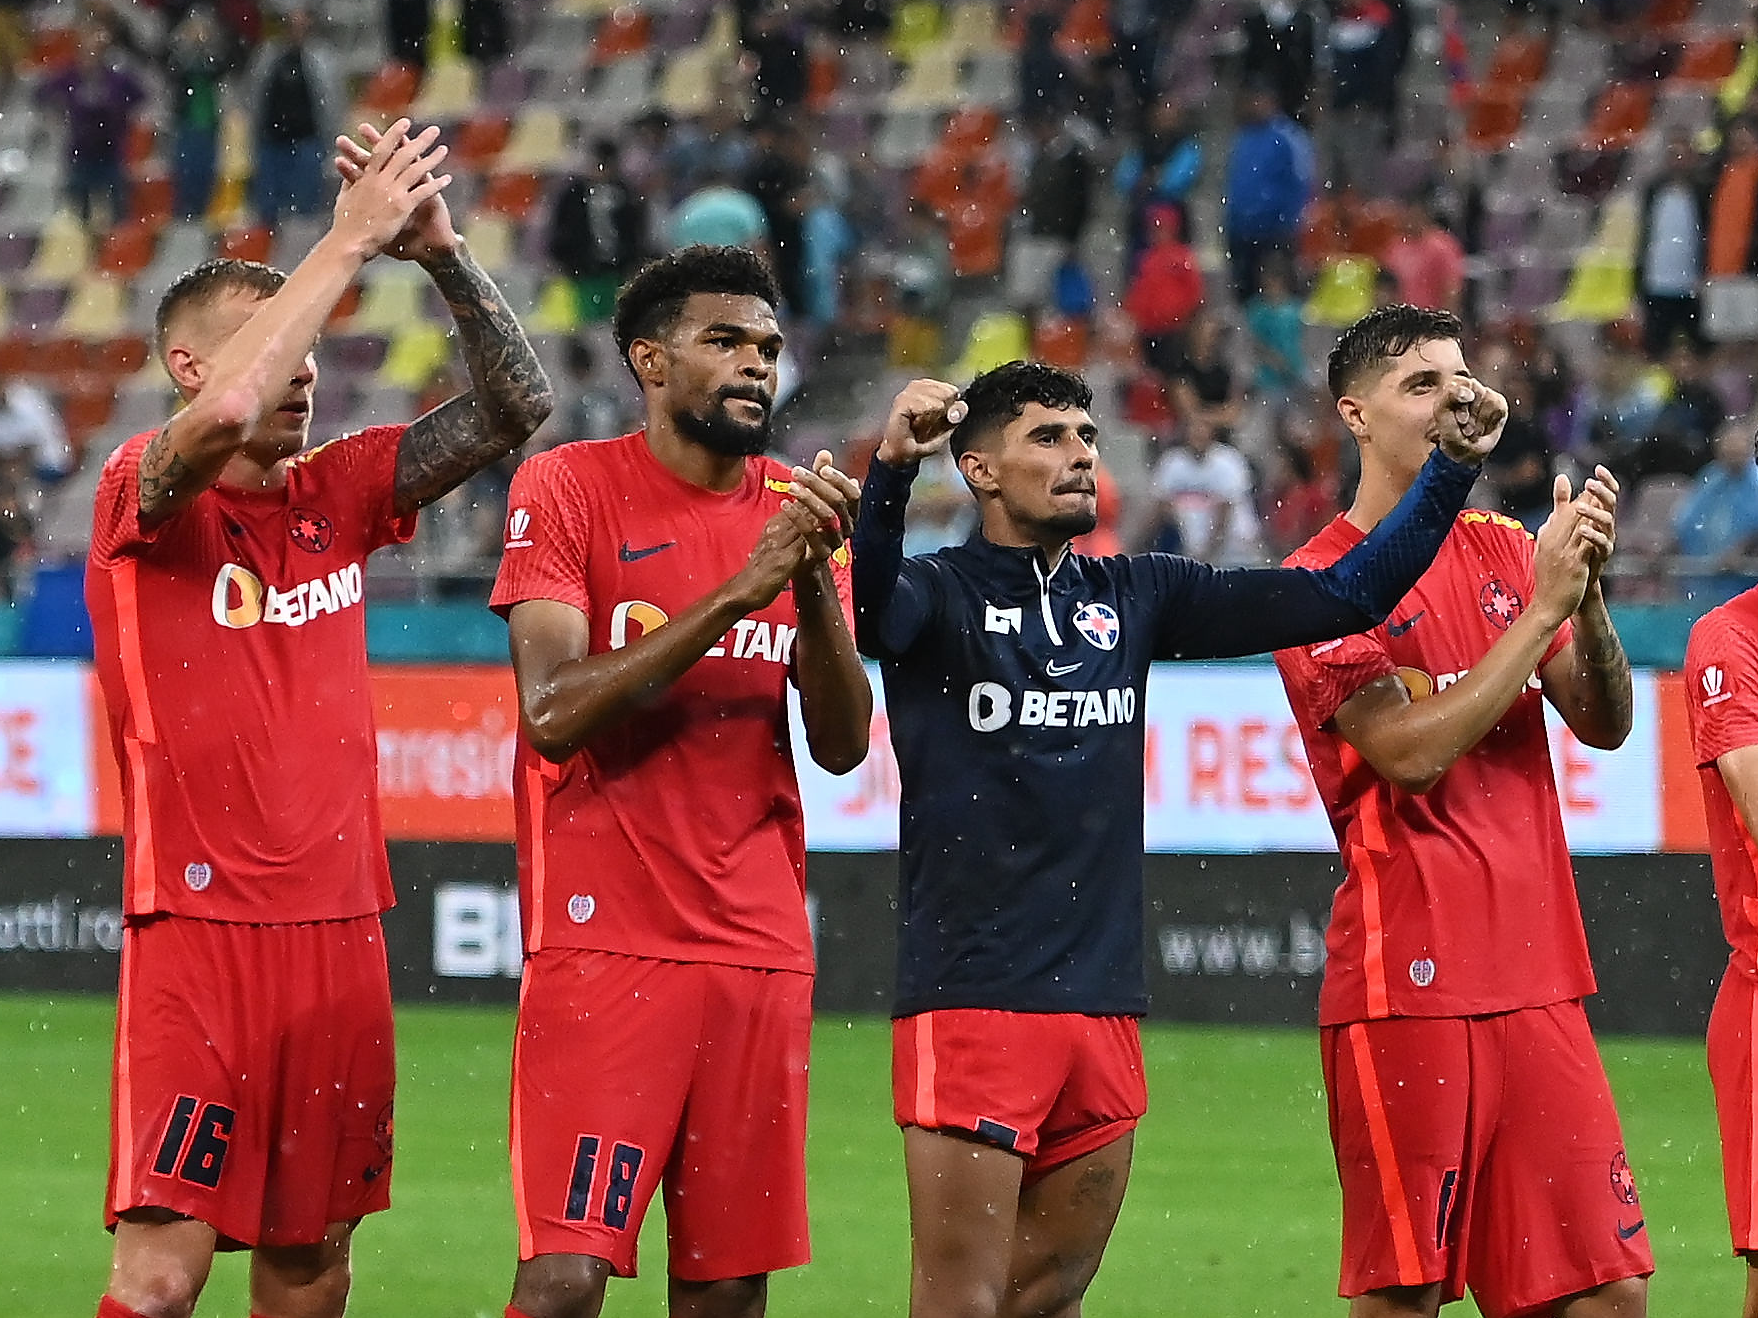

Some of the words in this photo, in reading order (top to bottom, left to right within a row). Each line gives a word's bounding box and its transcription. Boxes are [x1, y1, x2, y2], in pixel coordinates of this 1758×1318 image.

[262, 561, 363, 627] BETANO
[1018, 686, 1136, 727] BETANO
[149, 1094, 235, 1189] 16
[563, 1134, 646, 1231] 18
